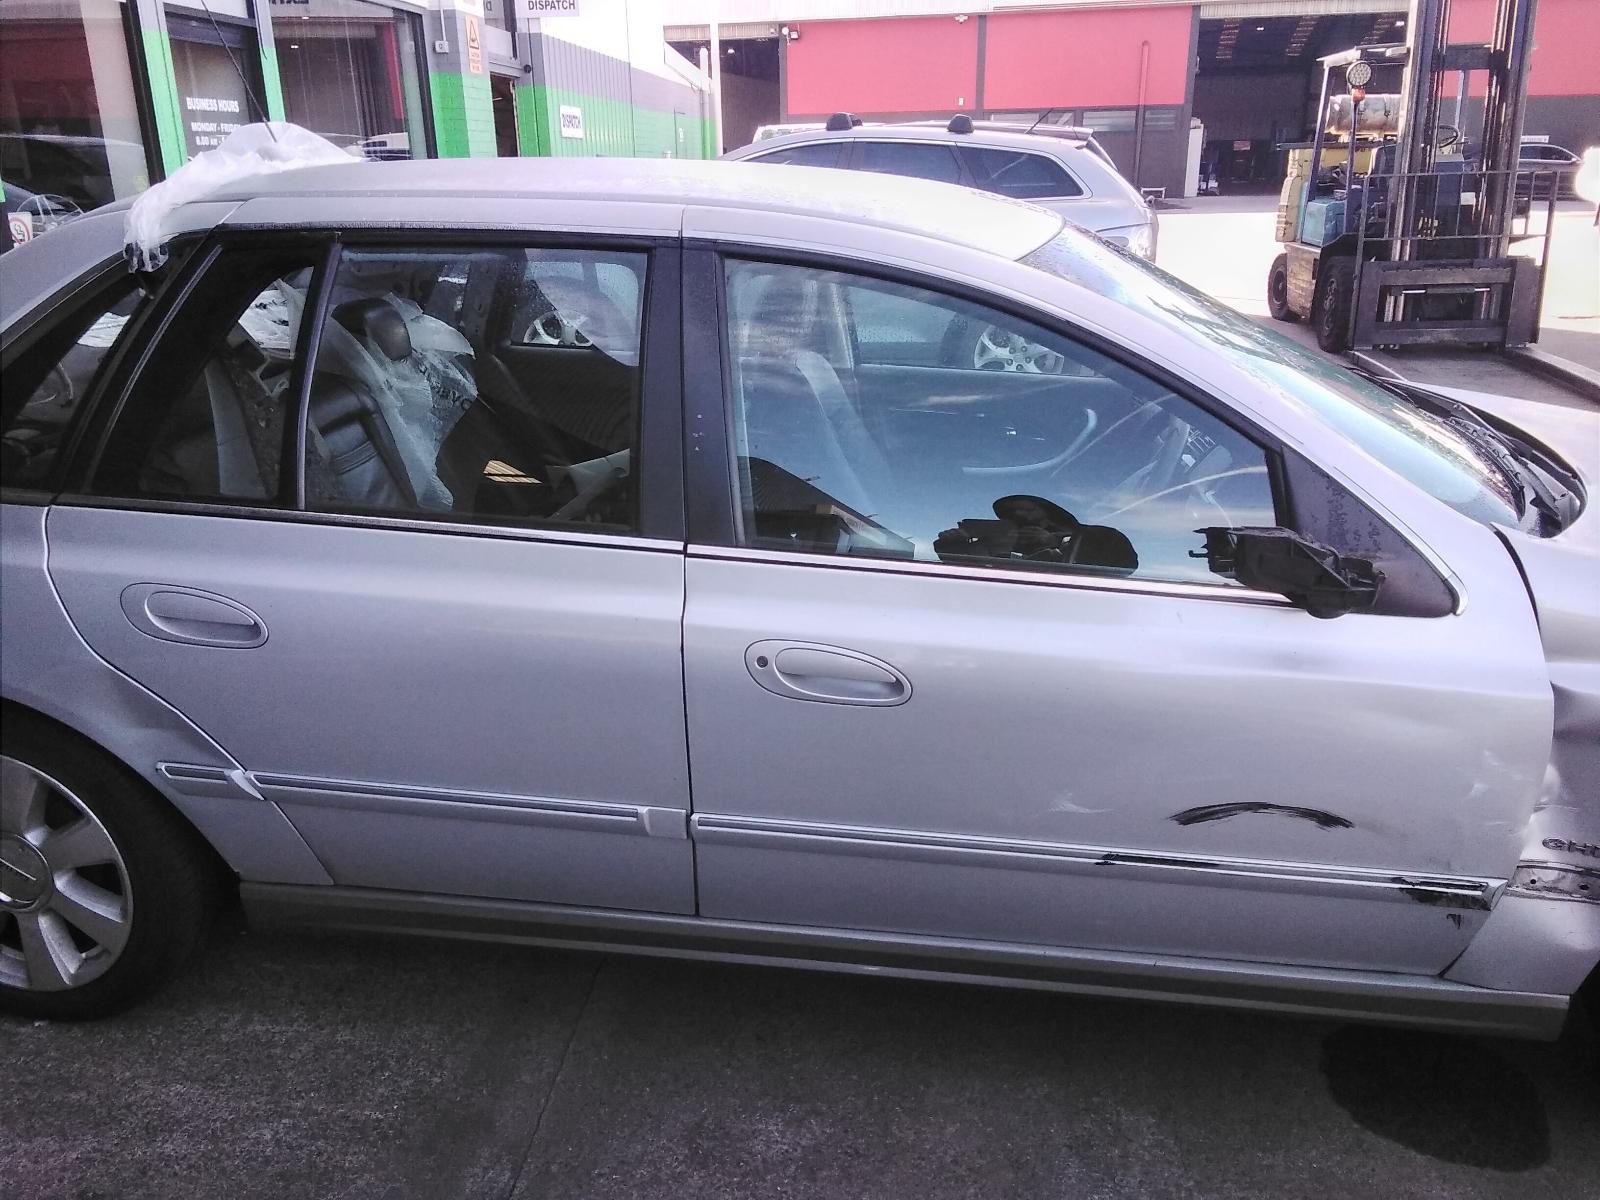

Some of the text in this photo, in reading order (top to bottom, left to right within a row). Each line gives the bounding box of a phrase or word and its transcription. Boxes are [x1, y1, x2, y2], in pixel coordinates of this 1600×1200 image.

[528, 0, 576, 10] DISPATCH
[186, 97, 240, 113] BUSINESS HOURS
[562, 113, 582, 128] DISPATCH
[191, 122, 217, 132] MONDAY
